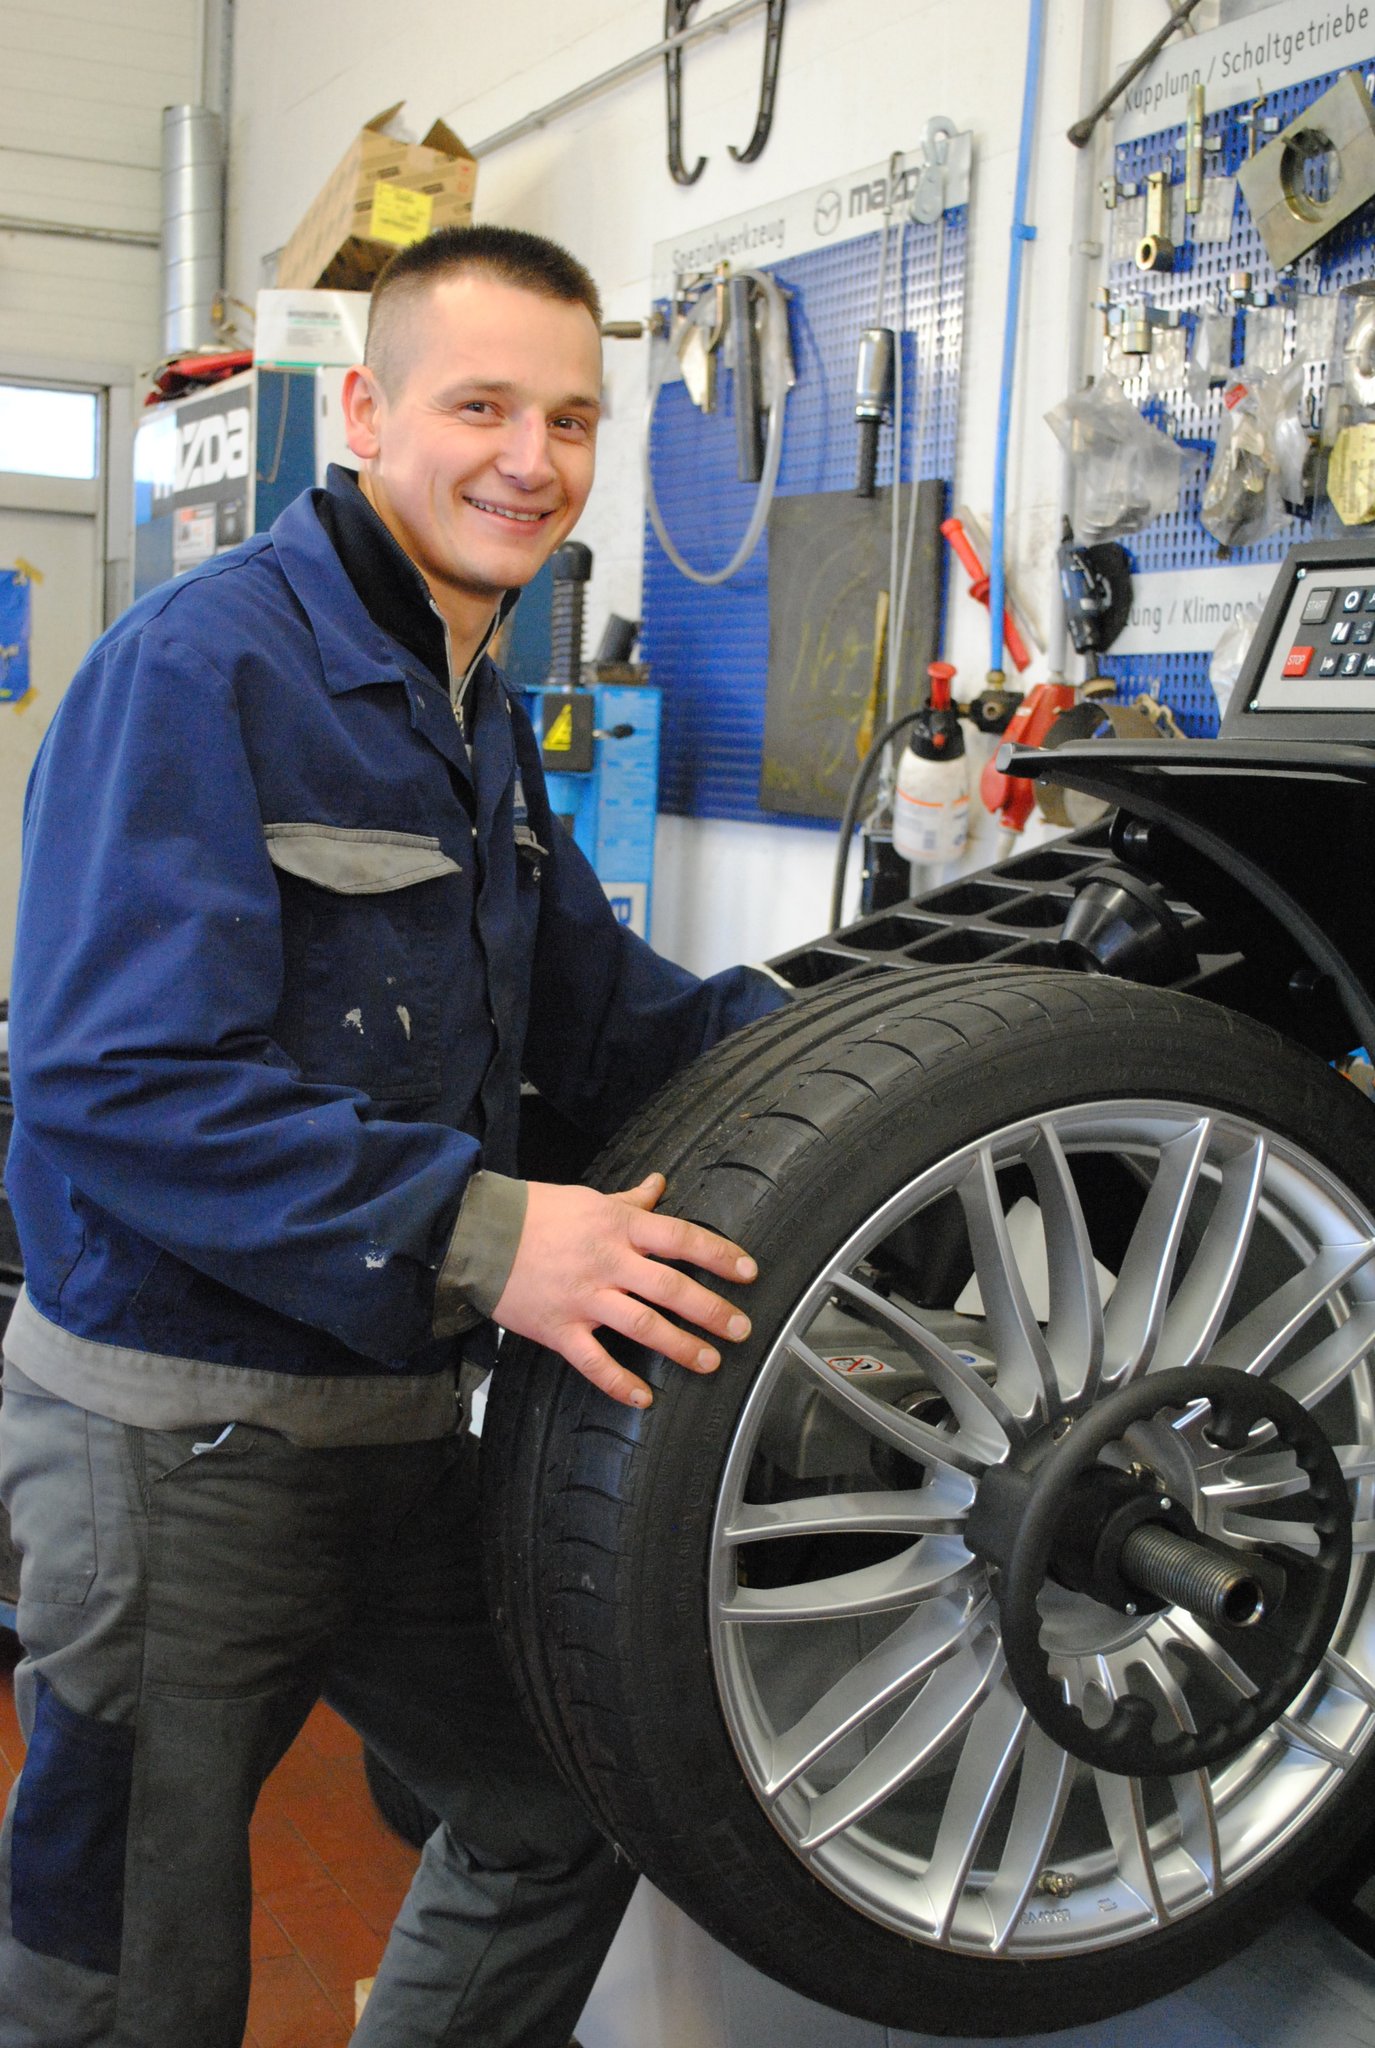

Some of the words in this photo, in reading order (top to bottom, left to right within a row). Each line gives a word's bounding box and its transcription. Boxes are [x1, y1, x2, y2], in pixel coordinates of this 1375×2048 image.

[1221, 3, 1369, 78] Schaltgetriebe
[1306, 600, 1329, 612] START
[1130, 607, 1162, 634] ung
[1287, 655, 1307, 666] STOP
